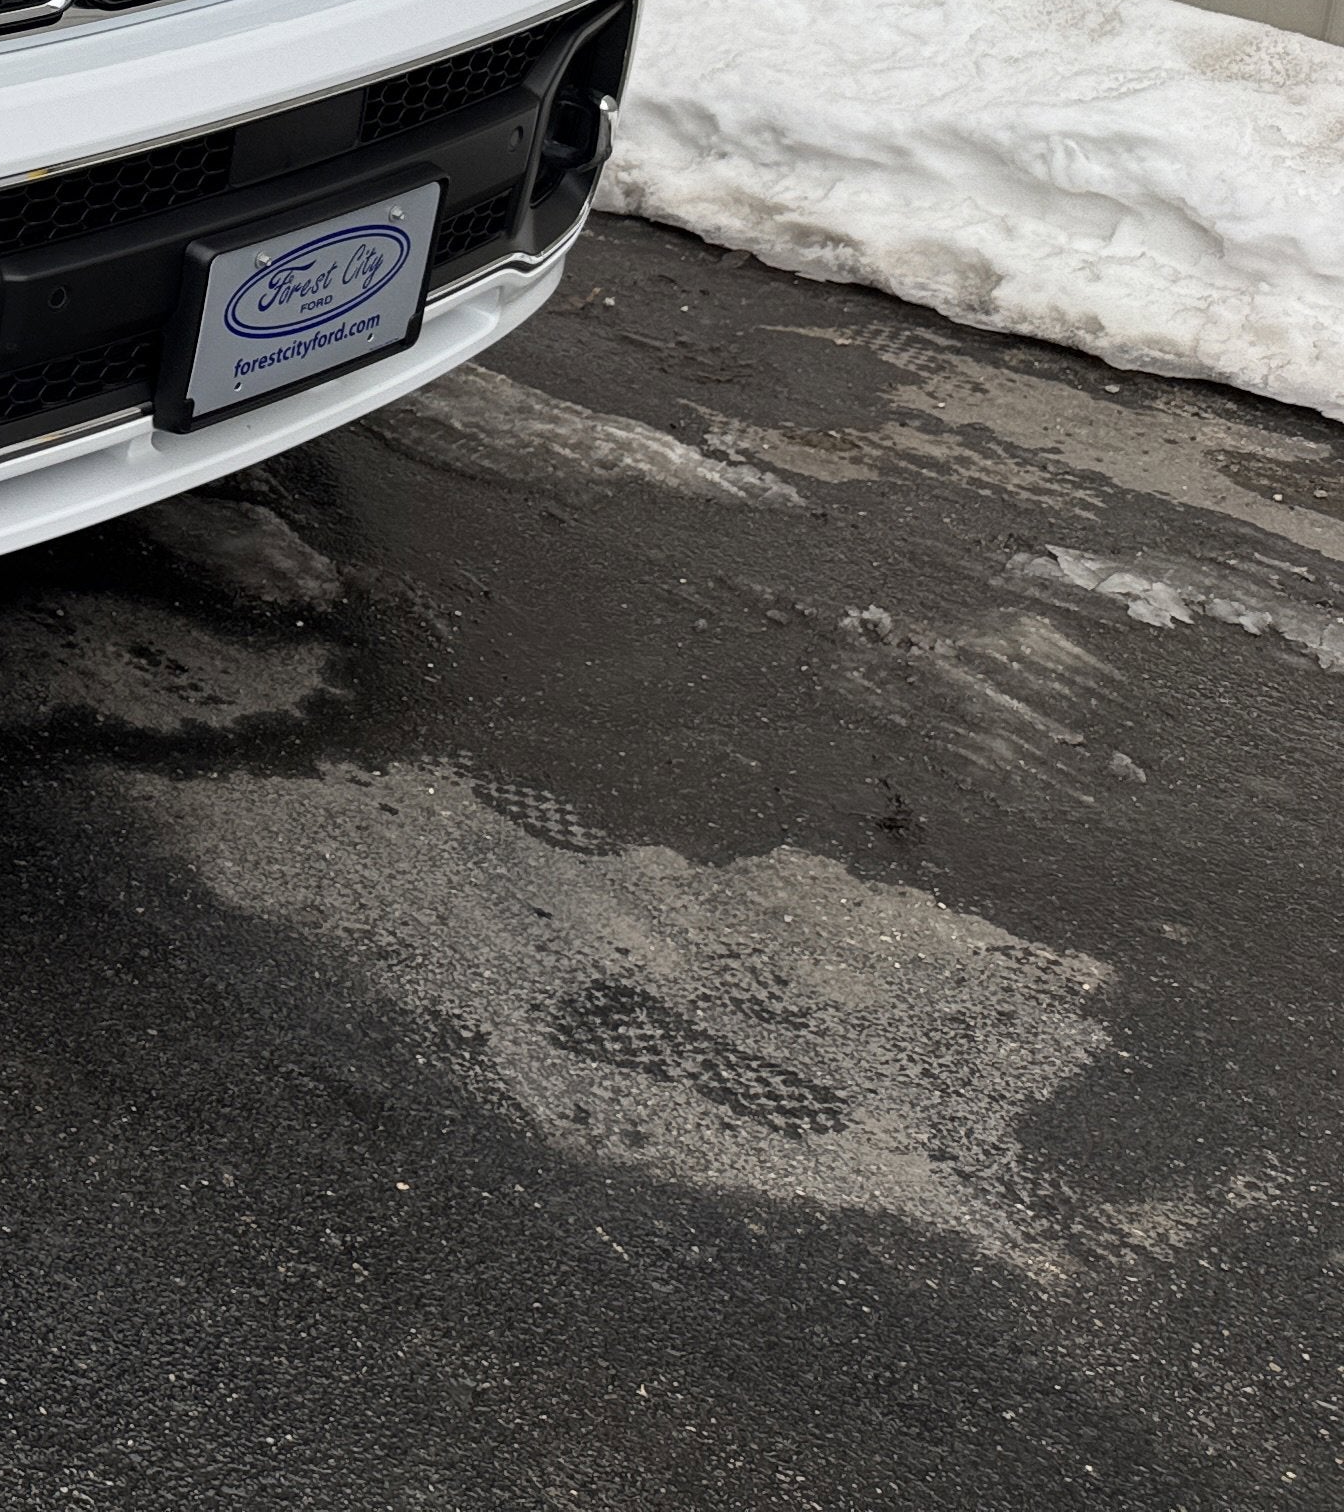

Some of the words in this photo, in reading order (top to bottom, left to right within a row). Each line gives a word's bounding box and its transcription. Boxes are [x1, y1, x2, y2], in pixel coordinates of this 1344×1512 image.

[258, 260, 338, 312] Forest
[342, 243, 384, 290] City
[300, 295, 333, 313] FORD
[233, 313, 380, 378] forestcityford.com
